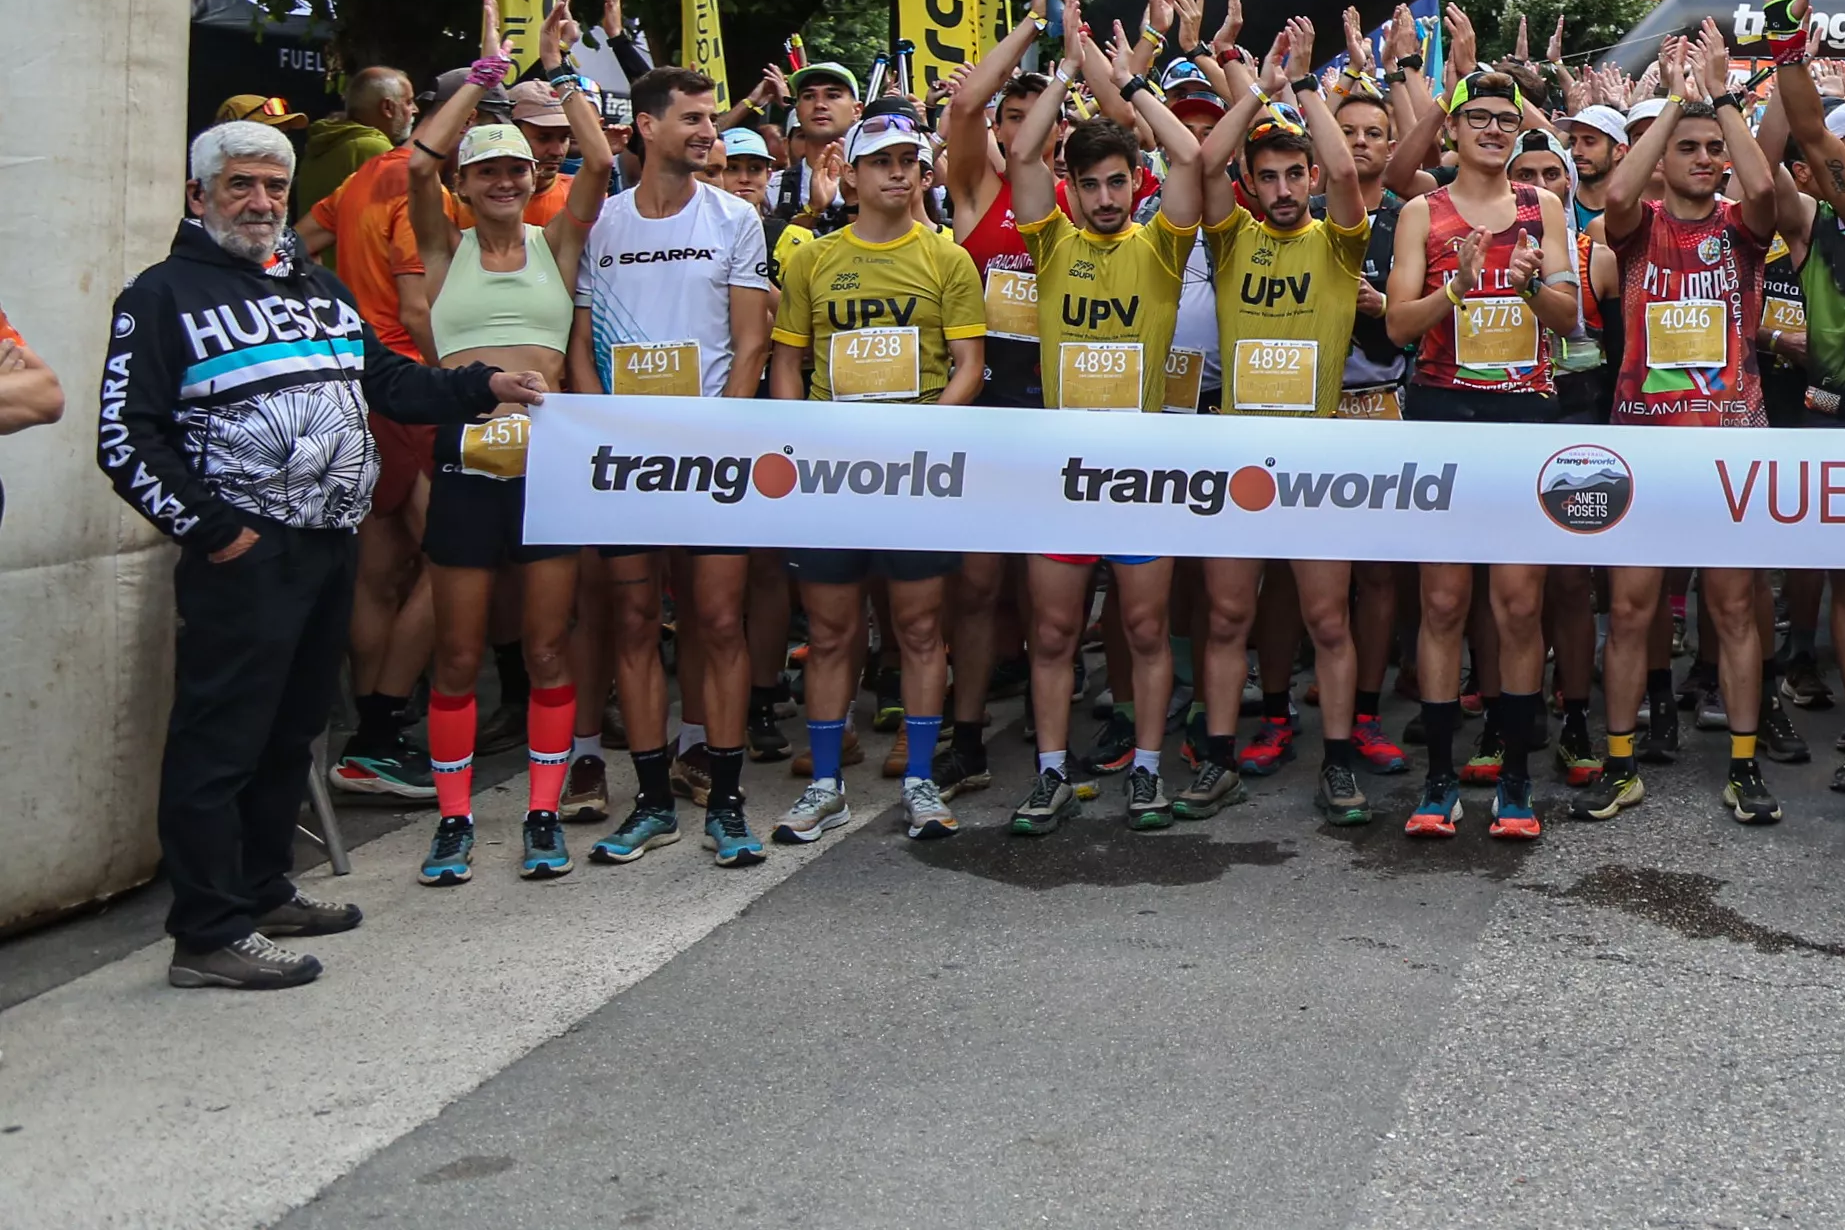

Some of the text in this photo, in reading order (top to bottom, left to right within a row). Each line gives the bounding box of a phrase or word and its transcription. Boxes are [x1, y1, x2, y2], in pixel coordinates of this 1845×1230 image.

[279, 48, 326, 72] FUEL
[619, 248, 714, 265] SCARPA
[830, 282, 861, 291] SDUPV
[1001, 279, 1038, 303] 456
[1240, 272, 1311, 308] UPV
[828, 297, 917, 331] UPV
[1062, 293, 1140, 330] UPV
[1472, 305, 1523, 328] 4778
[1660, 307, 1711, 330] 4046
[1774, 306, 1806, 326] 429
[181, 295, 365, 360] HUESCA
[847, 335, 901, 358] 4738
[627, 349, 681, 374] 4491
[1074, 351, 1126, 373] 4893
[1165, 353, 1189, 375] 03
[1249, 347, 1301, 370] 4892
[100, 352, 136, 468] GUARA
[1338, 392, 1386, 415] 4802
[481, 421, 531, 445] 451
[591, 445, 967, 504] trangoworld
[1061, 457, 1458, 516] trangoworld
[1575, 491, 1608, 505] ANETO
[1567, 504, 1608, 518] POSETS
